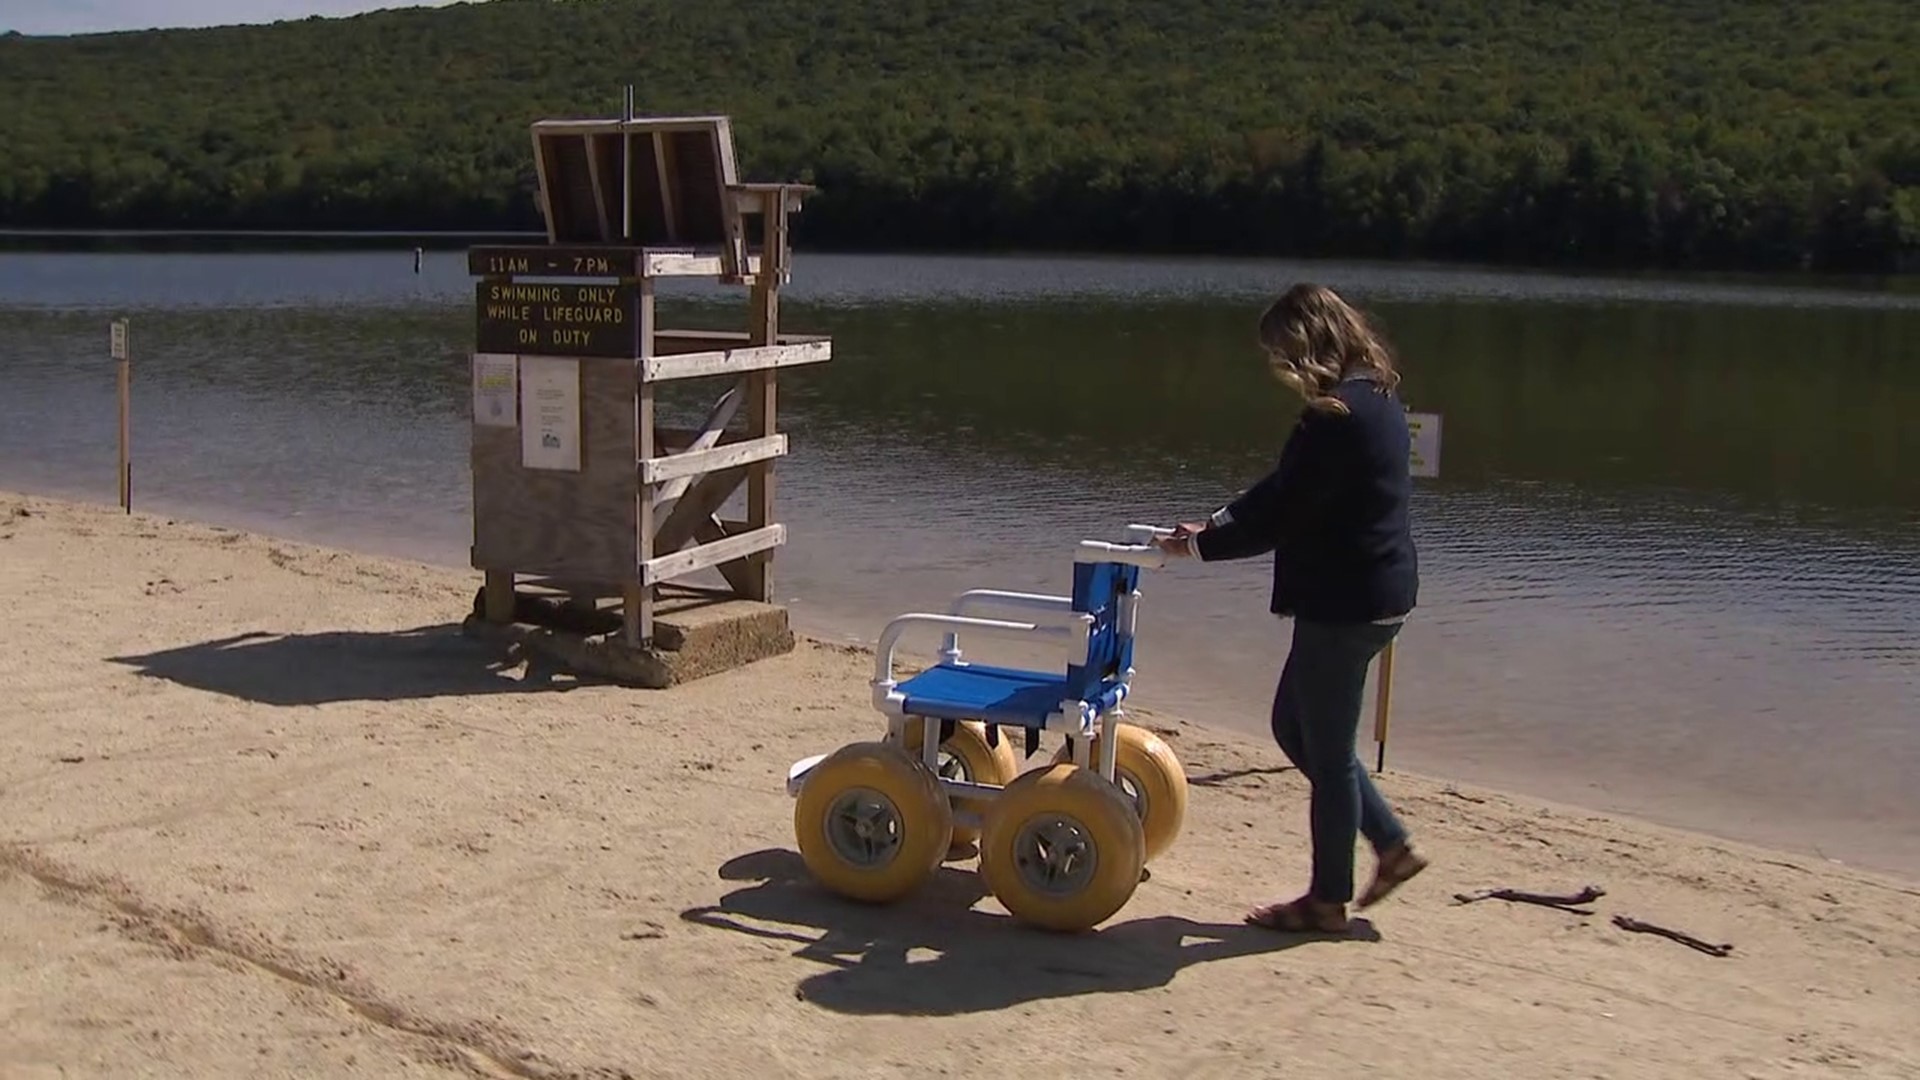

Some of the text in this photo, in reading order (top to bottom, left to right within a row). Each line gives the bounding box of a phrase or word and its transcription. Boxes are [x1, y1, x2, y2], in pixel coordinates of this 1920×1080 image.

[491, 286, 616, 303] SWIMMING ONLY
[487, 306, 623, 323] WHILE LIFEGUARD
[519, 329, 591, 346] ON DUTY
